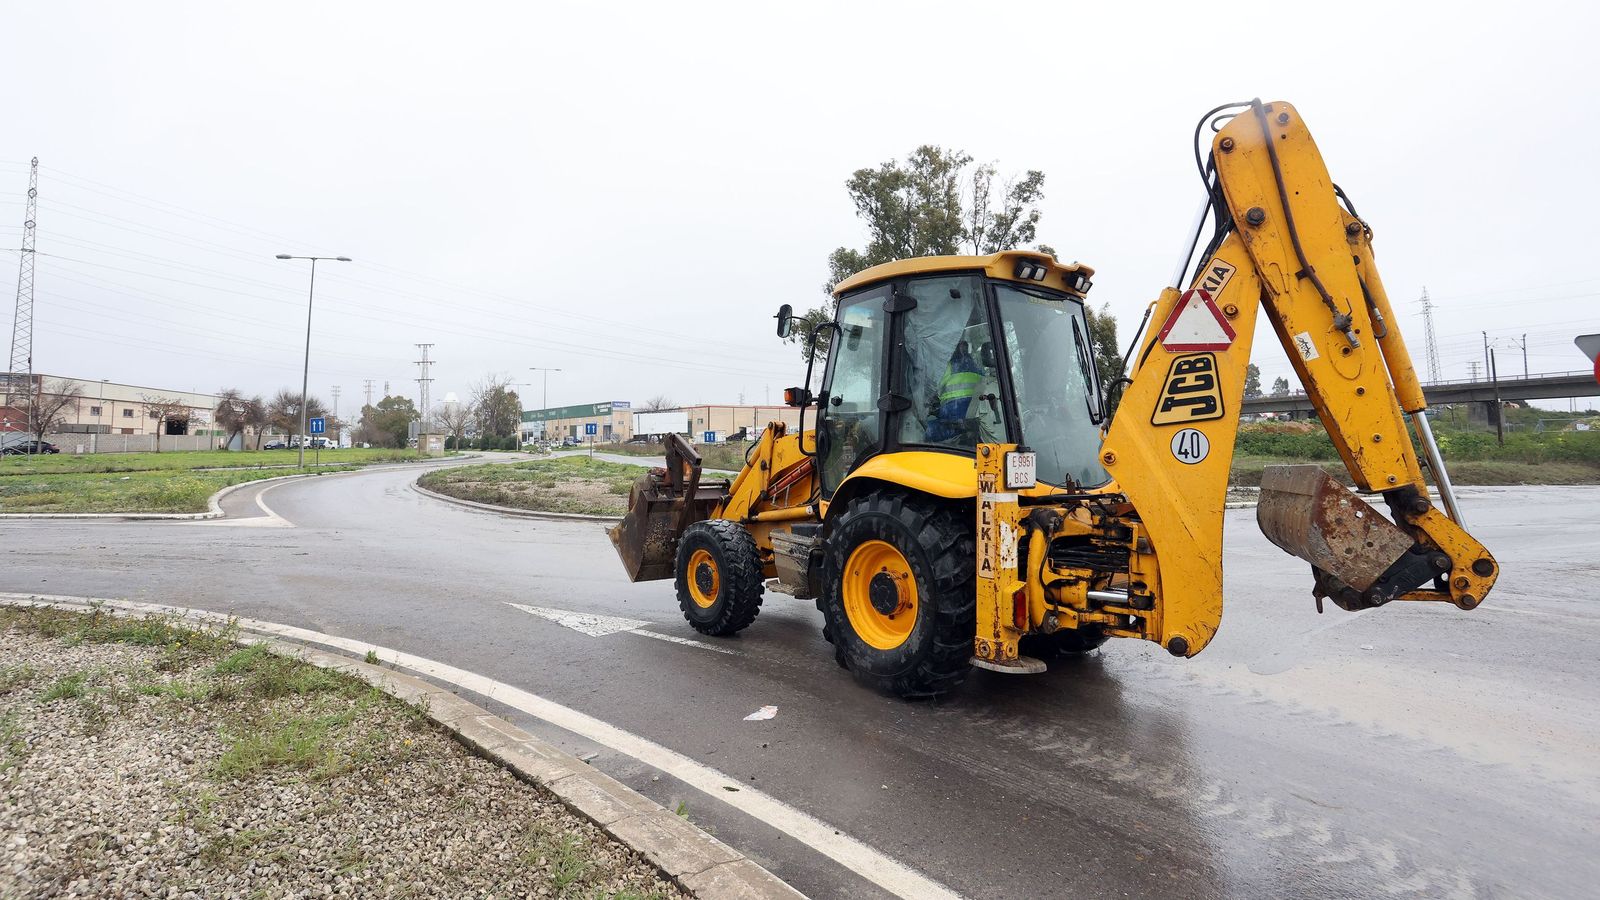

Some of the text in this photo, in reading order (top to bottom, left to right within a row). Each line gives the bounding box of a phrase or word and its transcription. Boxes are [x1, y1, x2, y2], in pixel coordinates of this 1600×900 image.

[1202, 266, 1230, 293] KIA
[1160, 357, 1217, 416] JCB
[1178, 432, 1200, 459] 40
[1014, 472, 1029, 484] BCS
[980, 481, 993, 571] WALKIA
